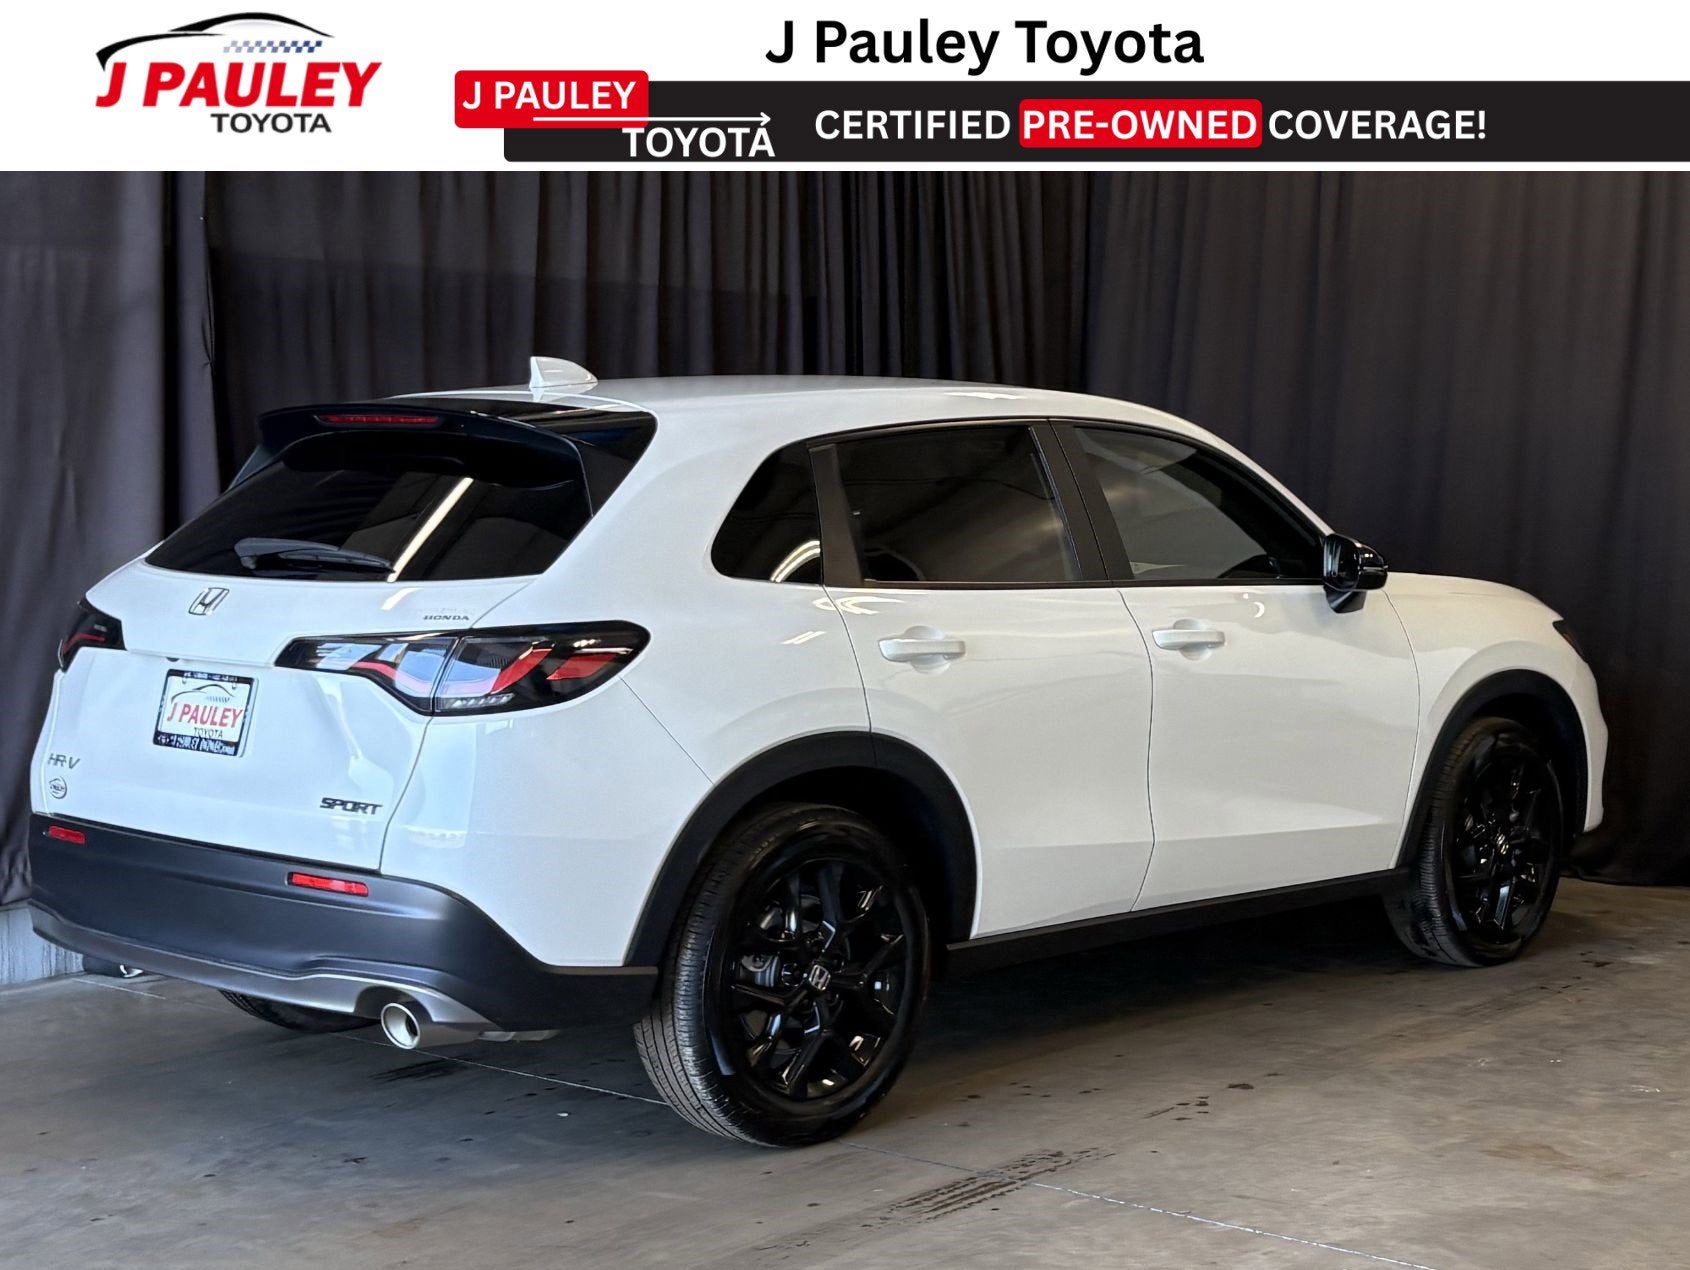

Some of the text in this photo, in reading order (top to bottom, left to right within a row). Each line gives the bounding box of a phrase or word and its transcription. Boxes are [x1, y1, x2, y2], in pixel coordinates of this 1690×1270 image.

[167, 702, 243, 728] J PAULEY
[194, 726, 223, 739] TOYOTA
[319, 797, 383, 815] SPORT
